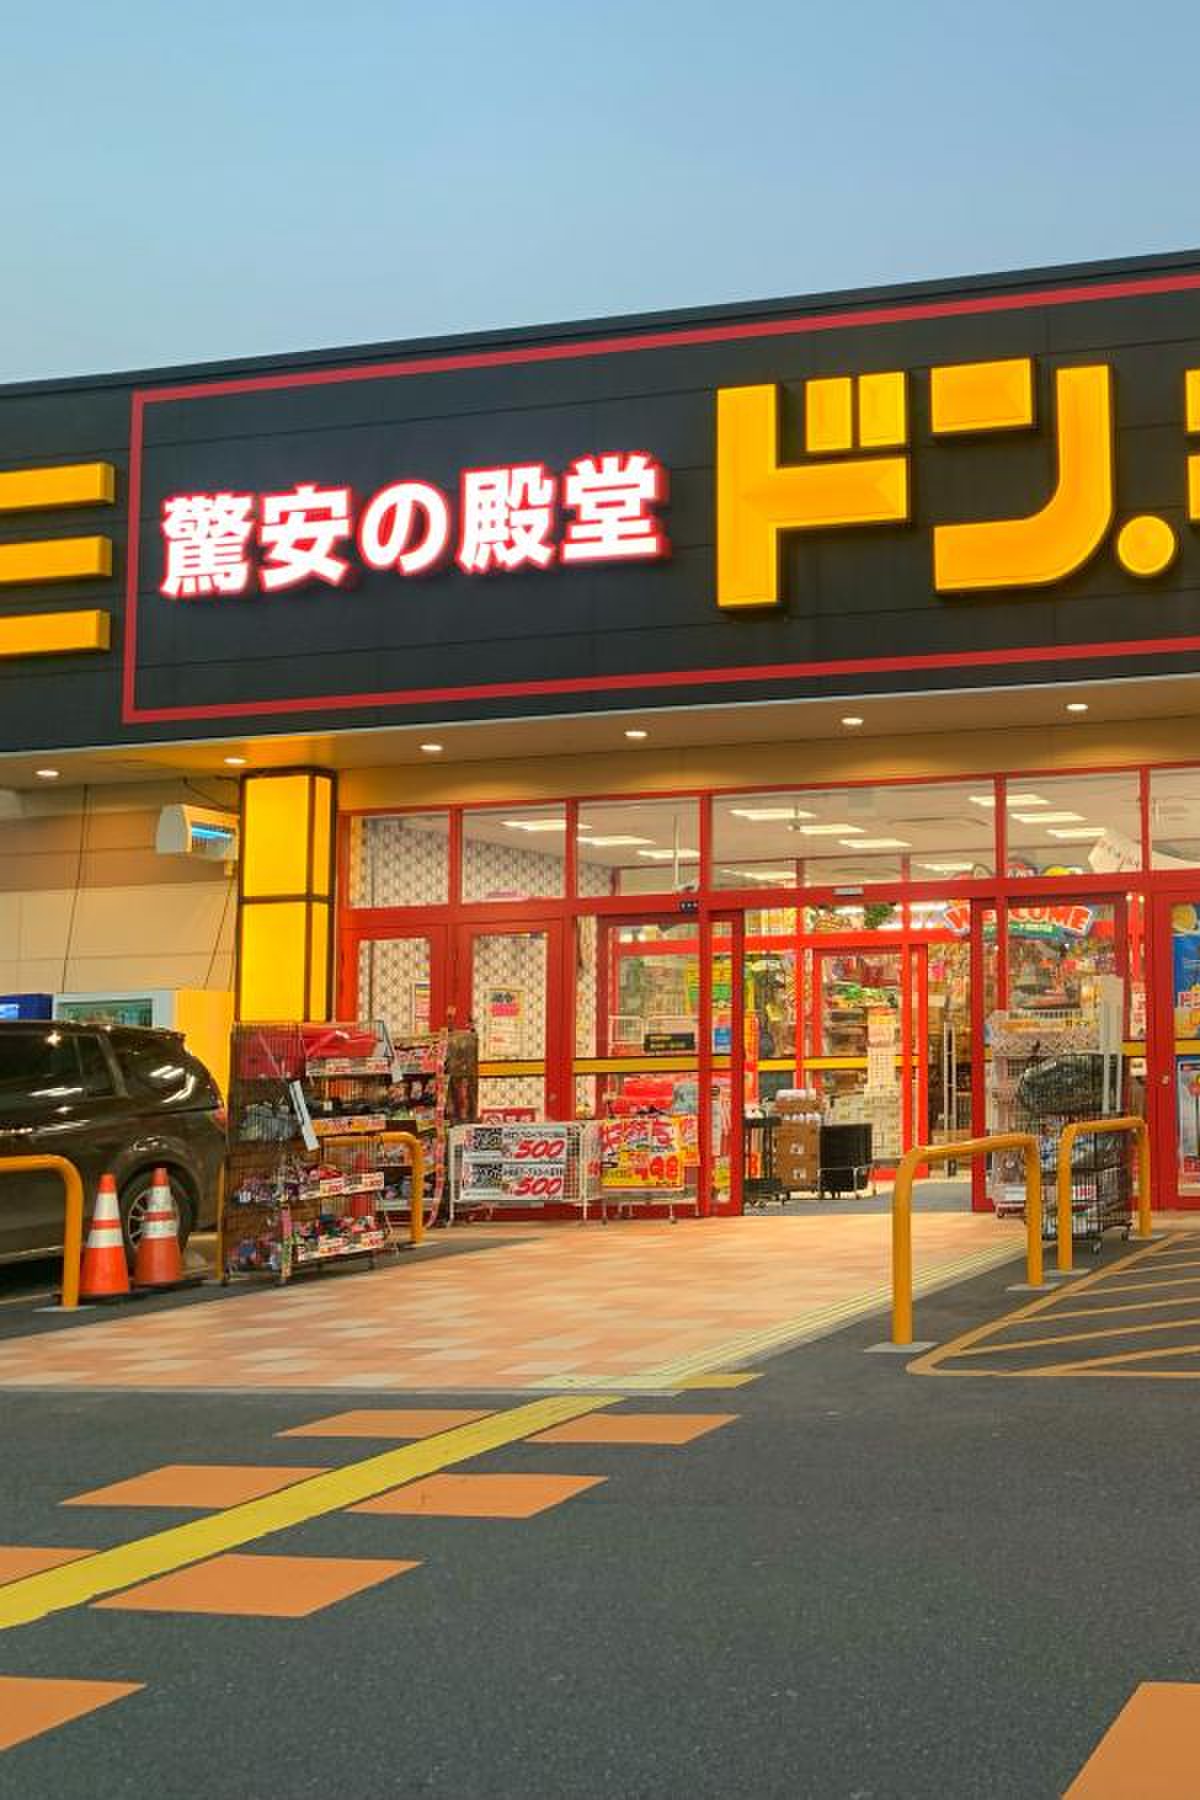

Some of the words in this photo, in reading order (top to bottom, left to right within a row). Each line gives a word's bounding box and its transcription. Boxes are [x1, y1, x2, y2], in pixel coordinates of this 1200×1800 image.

[160, 451, 662, 598] 驚安の殿堂
[513, 1139, 565, 1160] 500
[512, 1175, 563, 1197] 500
